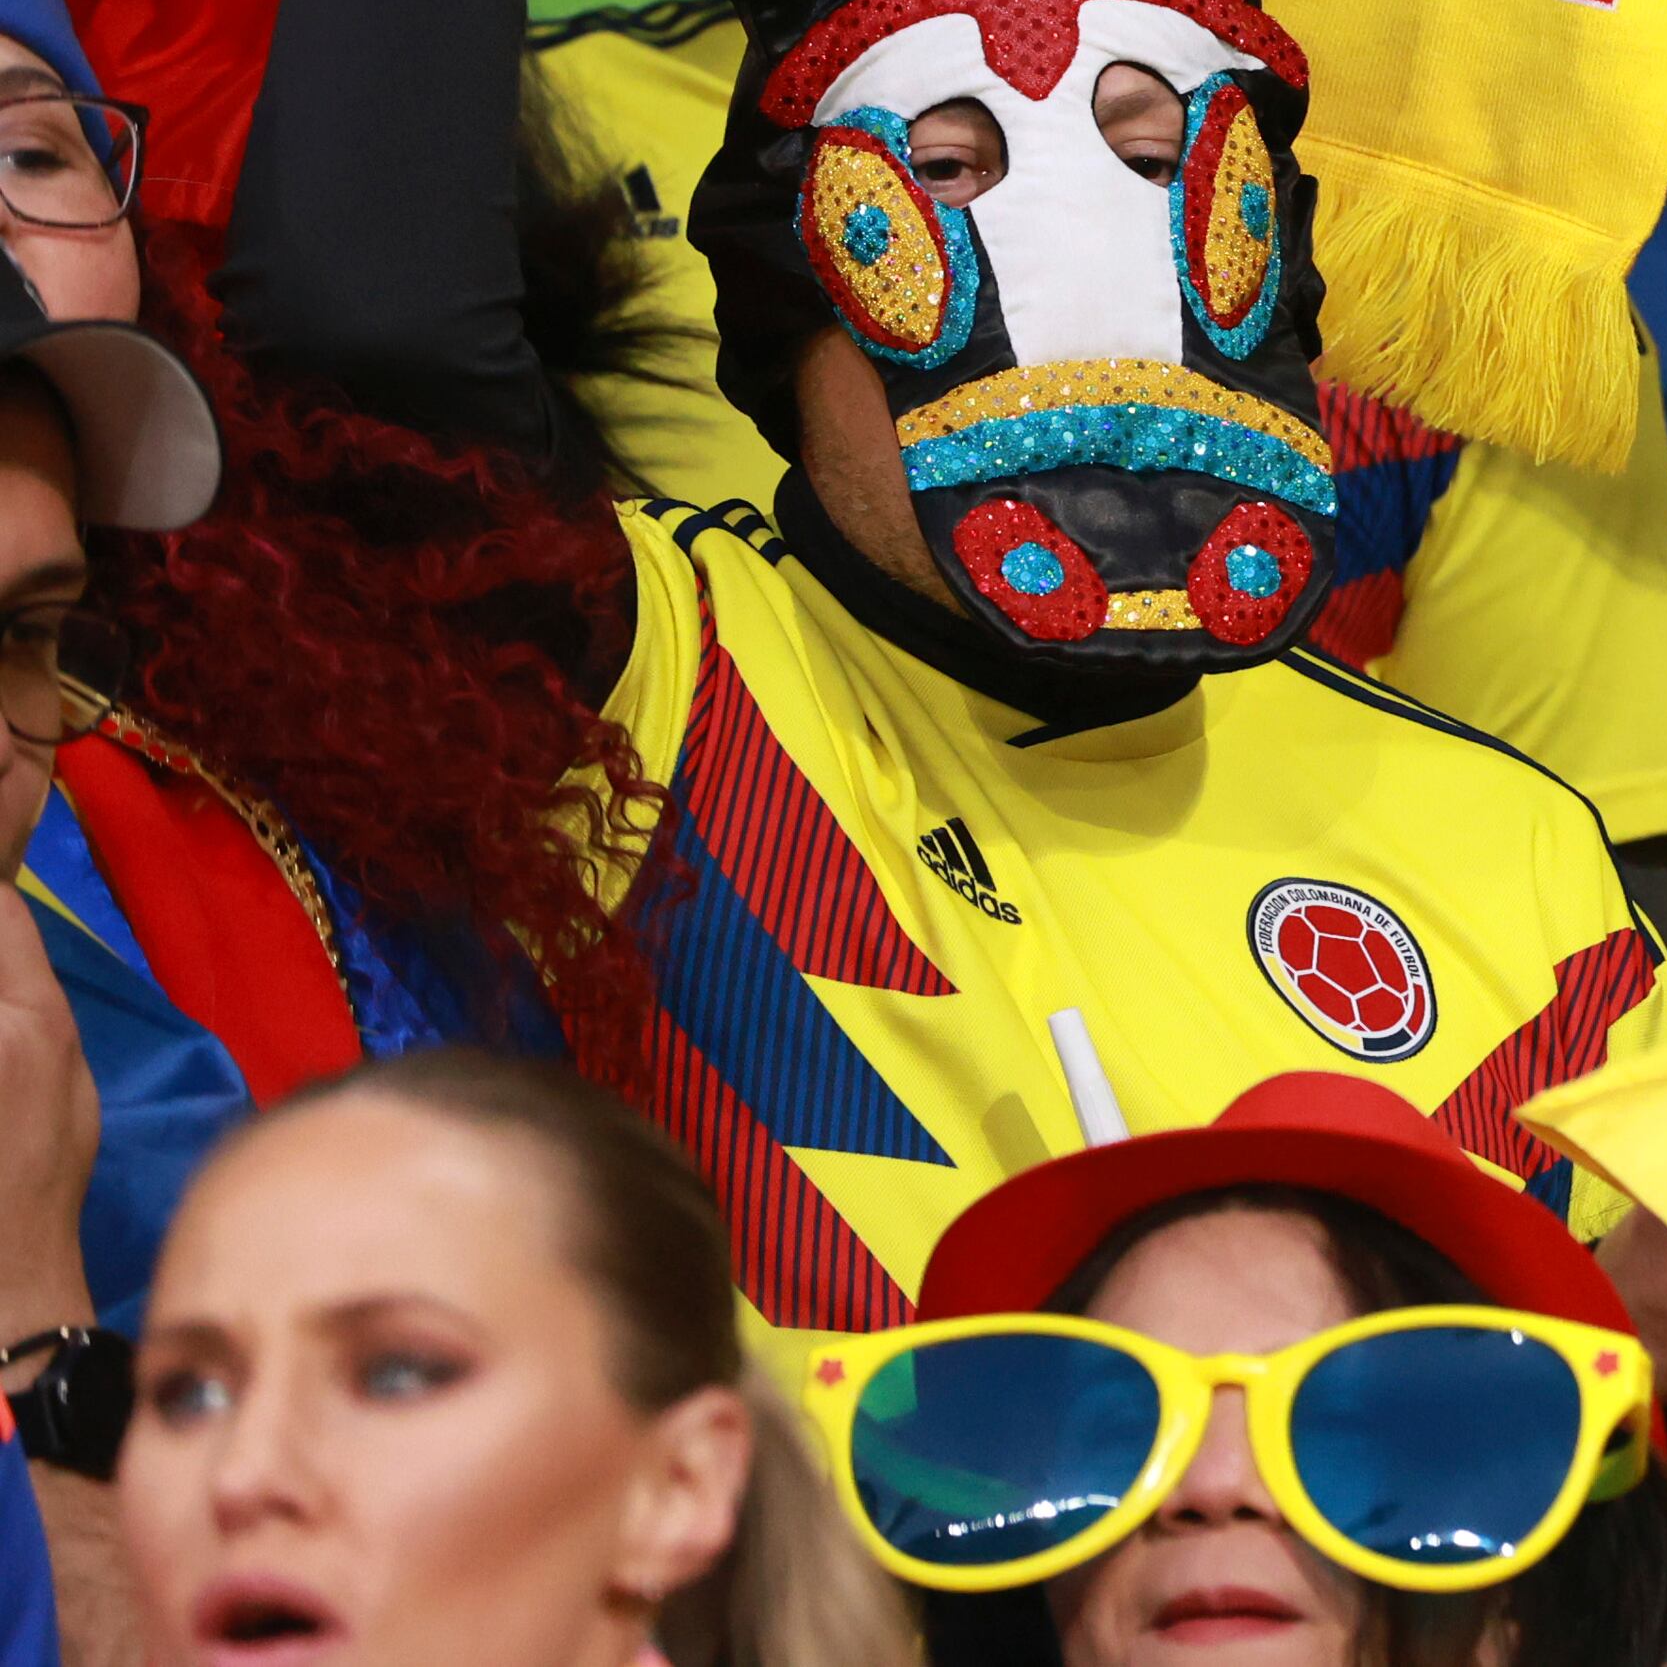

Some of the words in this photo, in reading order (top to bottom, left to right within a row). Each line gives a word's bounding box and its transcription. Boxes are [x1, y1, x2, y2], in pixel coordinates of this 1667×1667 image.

[917, 845, 1022, 925] adidas
[1259, 893, 1290, 954] FEDERACION
[1287, 888, 1371, 917] COLOMBIANA
[1374, 913, 1391, 931] DE
[1389, 930, 1420, 980] FUTBOL
